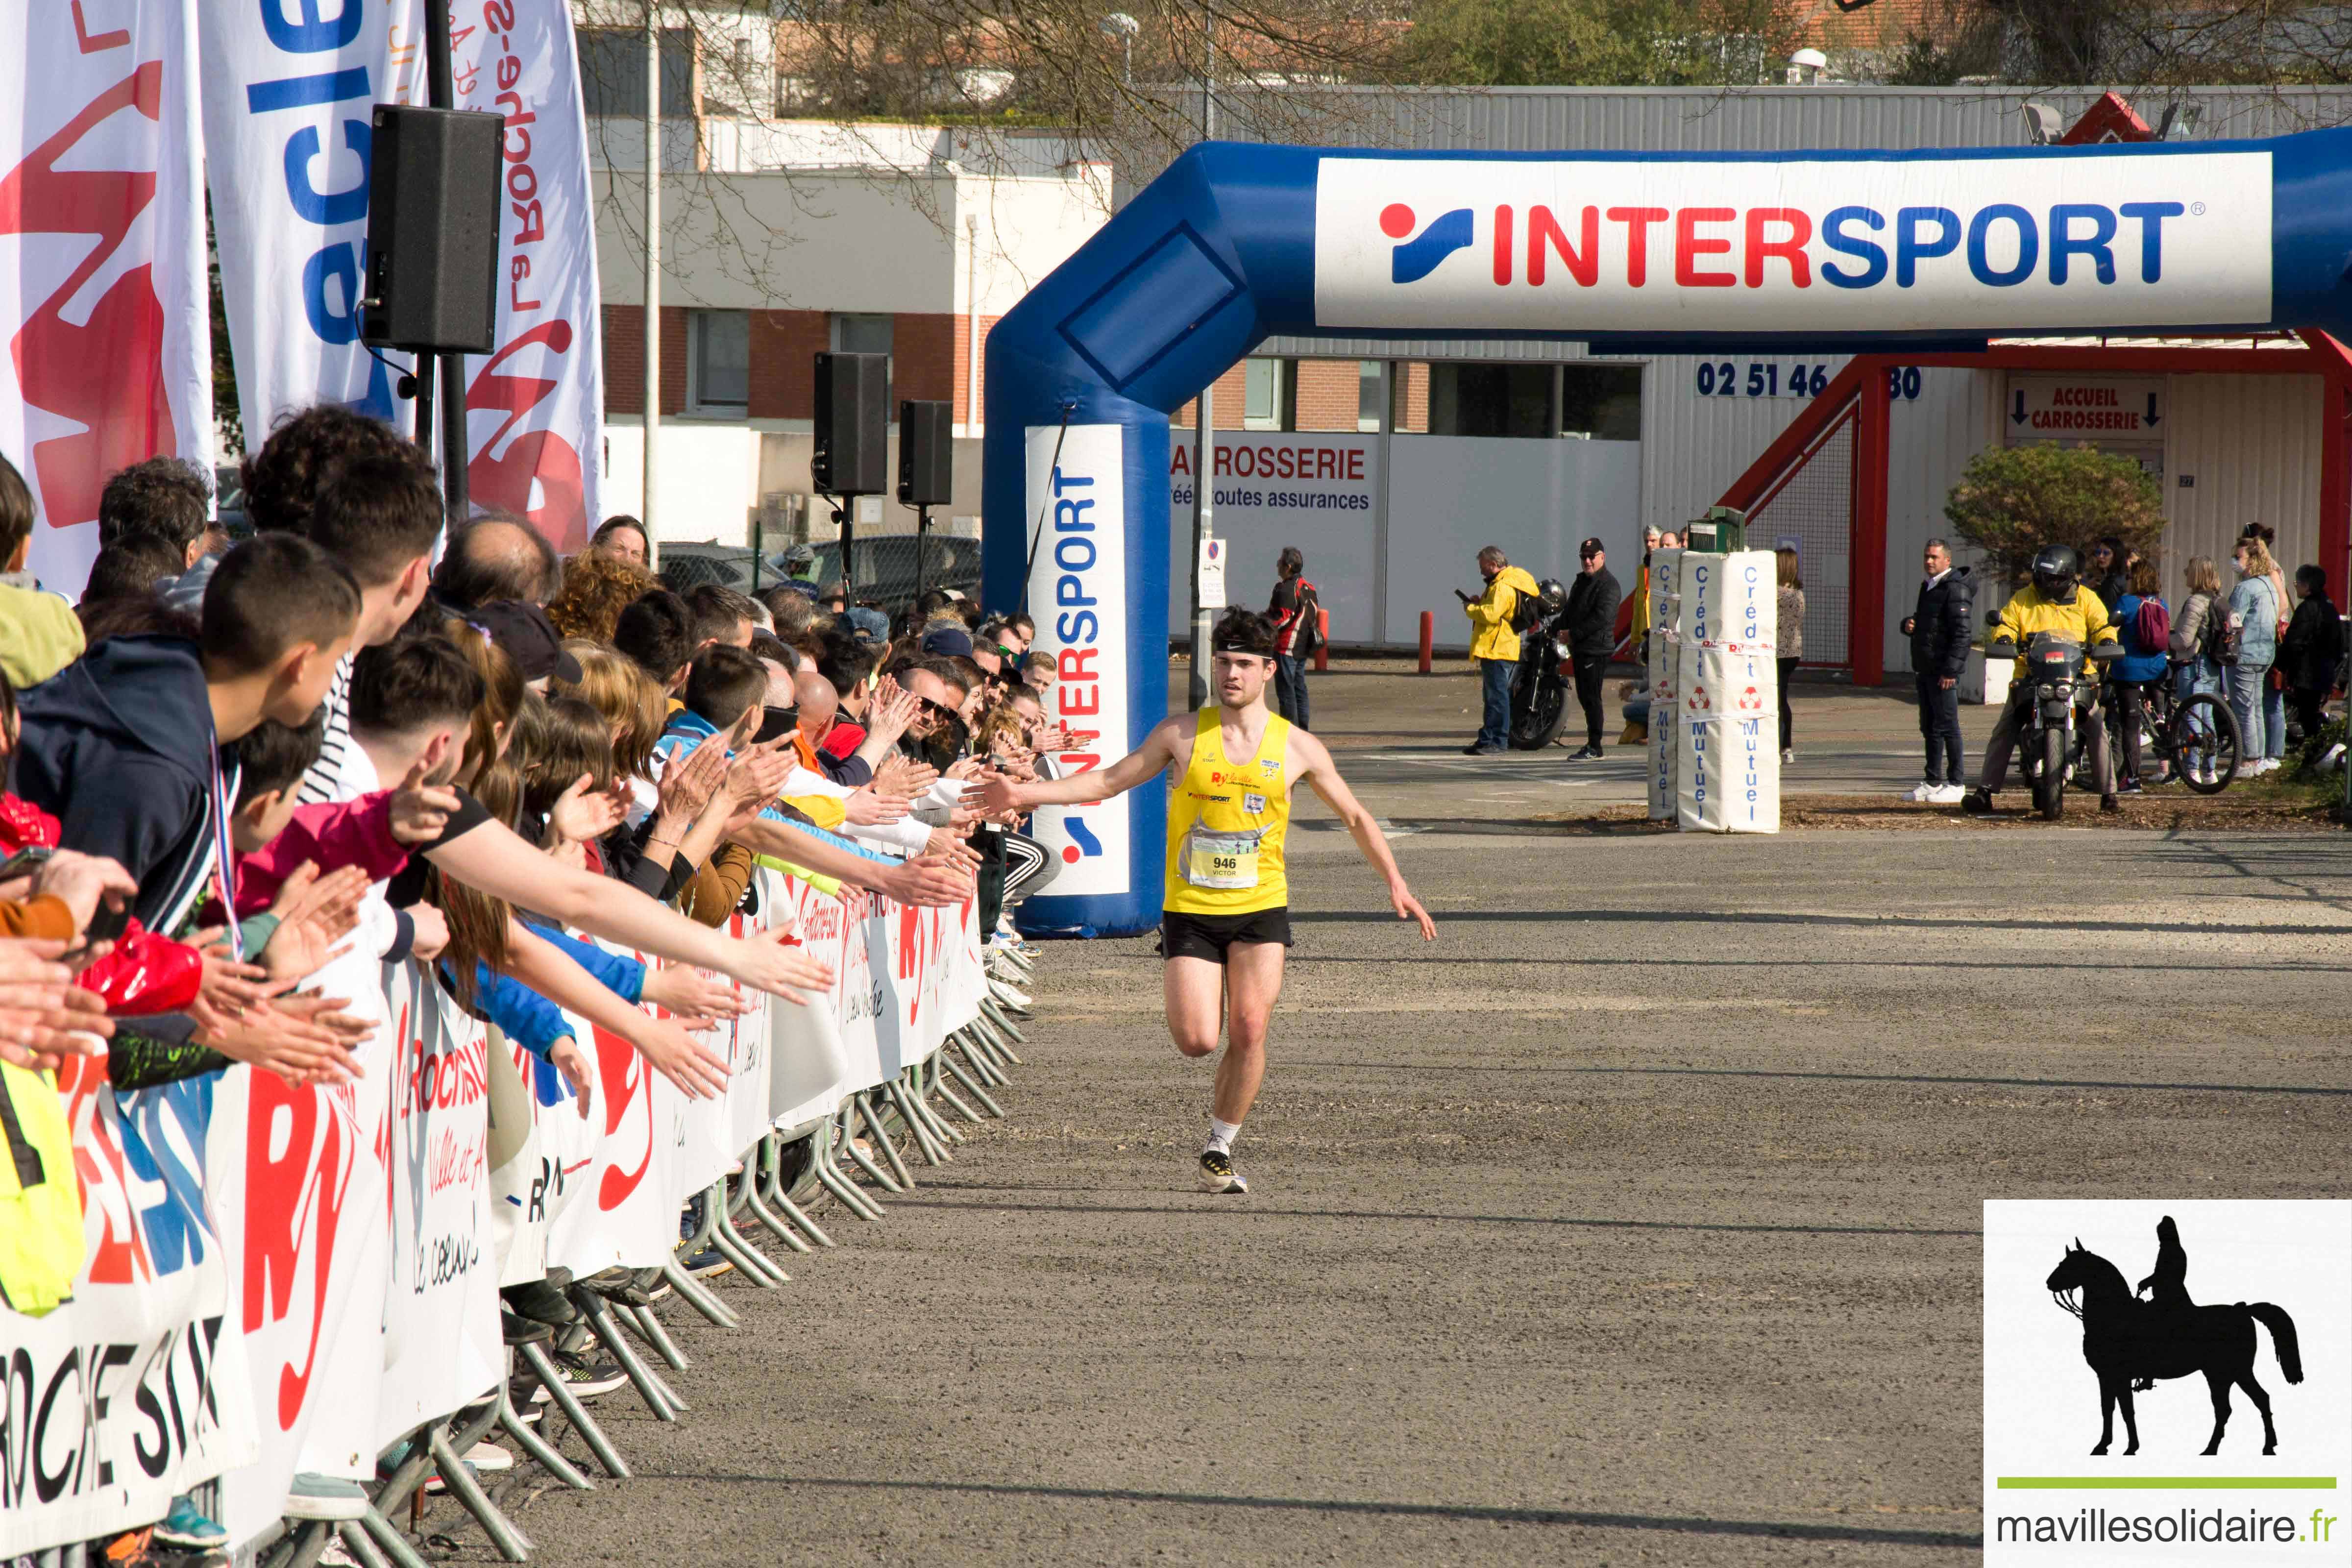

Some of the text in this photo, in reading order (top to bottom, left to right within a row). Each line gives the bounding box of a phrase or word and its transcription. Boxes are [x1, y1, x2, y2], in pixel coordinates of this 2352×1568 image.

[1493, 202, 2185, 289] INTERSPORT
[1697, 362, 1736, 395] 02
[1746, 363, 1778, 396] 51
[1788, 364, 1828, 397] 46
[2053, 388, 2118, 407] ACCUEIL
[2032, 410, 2139, 431] CARROSSERIE
[1170, 444, 1365, 480] AROSSERIE
[1267, 491, 1370, 510] assurances
[1053, 465, 1102, 807] NTERSPORT
[1742, 566, 1759, 821] Crédt Mutuel
[1656, 710, 1669, 810] Mutuel
[1692, 721, 1707, 821] Mutuel
[1192, 793, 1231, 803] INTERSPORT
[1213, 858, 1236, 869] 946
